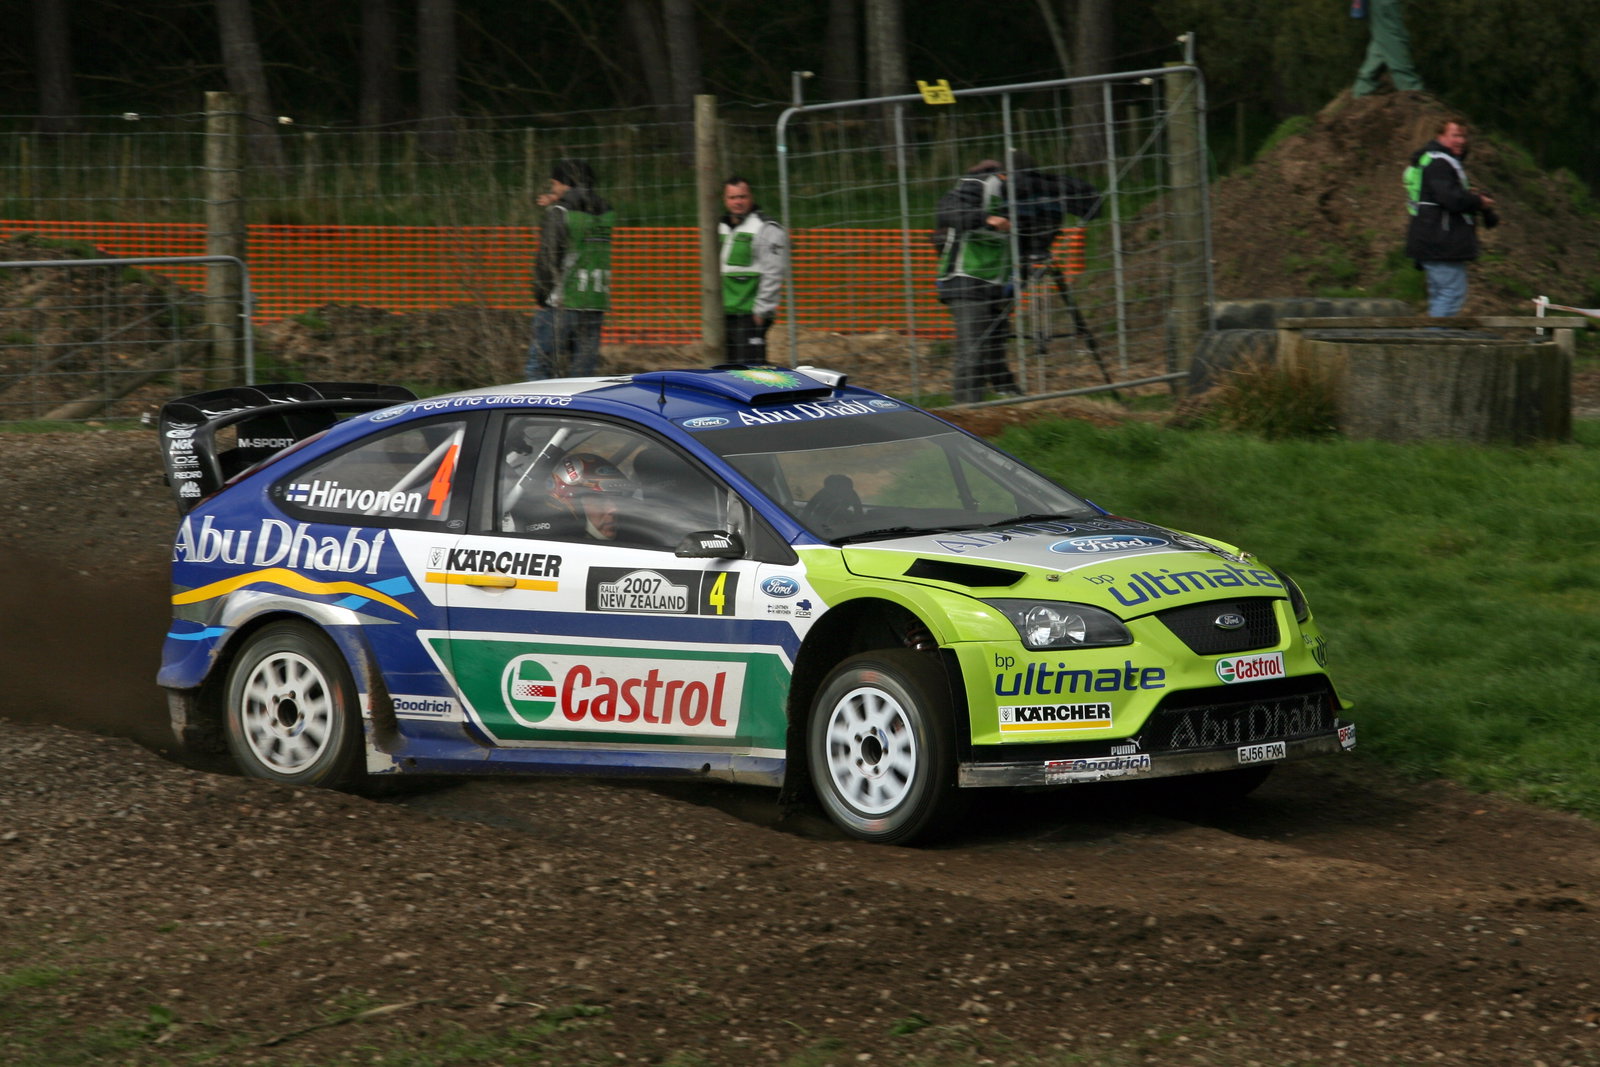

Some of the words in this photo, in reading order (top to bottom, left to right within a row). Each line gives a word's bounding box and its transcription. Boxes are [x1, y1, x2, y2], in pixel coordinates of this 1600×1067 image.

[412, 398, 451, 412] Feel
[454, 394, 482, 407] the
[486, 393, 572, 406] difference
[737, 408, 801, 426] Abu
[793, 399, 877, 419] Dhabi
[691, 418, 724, 428] Ford
[171, 438, 195, 450] NGK
[238, 438, 295, 448] M-SPORT
[428, 445, 459, 516] 4
[308, 480, 422, 513] Hirvonen
[172, 516, 252, 563] Abu
[253, 518, 387, 575] Dhabi
[700, 539, 729, 549] PUMA
[1071, 536, 1153, 553] Ford
[446, 547, 562, 578] KÄRCHER
[600, 585, 620, 593] RALLY
[623, 578, 662, 594] 2007
[766, 578, 795, 595] Ford
[1085, 573, 1116, 586] bp
[1109, 563, 1283, 607] ultimate
[600, 593, 627, 608] NEW
[630, 594, 686, 610] ZEALAND
[709, 572, 727, 615] 4
[995, 653, 1015, 668] bp
[1236, 657, 1283, 679] Castrol
[995, 660, 1166, 697] ultimate
[560, 664, 727, 728] Castrol
[1014, 703, 1110, 722] KÄRCHER
[1170, 711, 1243, 749] Abu
[1248, 694, 1323, 742] Dhabi
[1111, 744, 1136, 755] PUMA
[1240, 748, 1264, 763] EJ56
[1265, 744, 1285, 759] FXA
